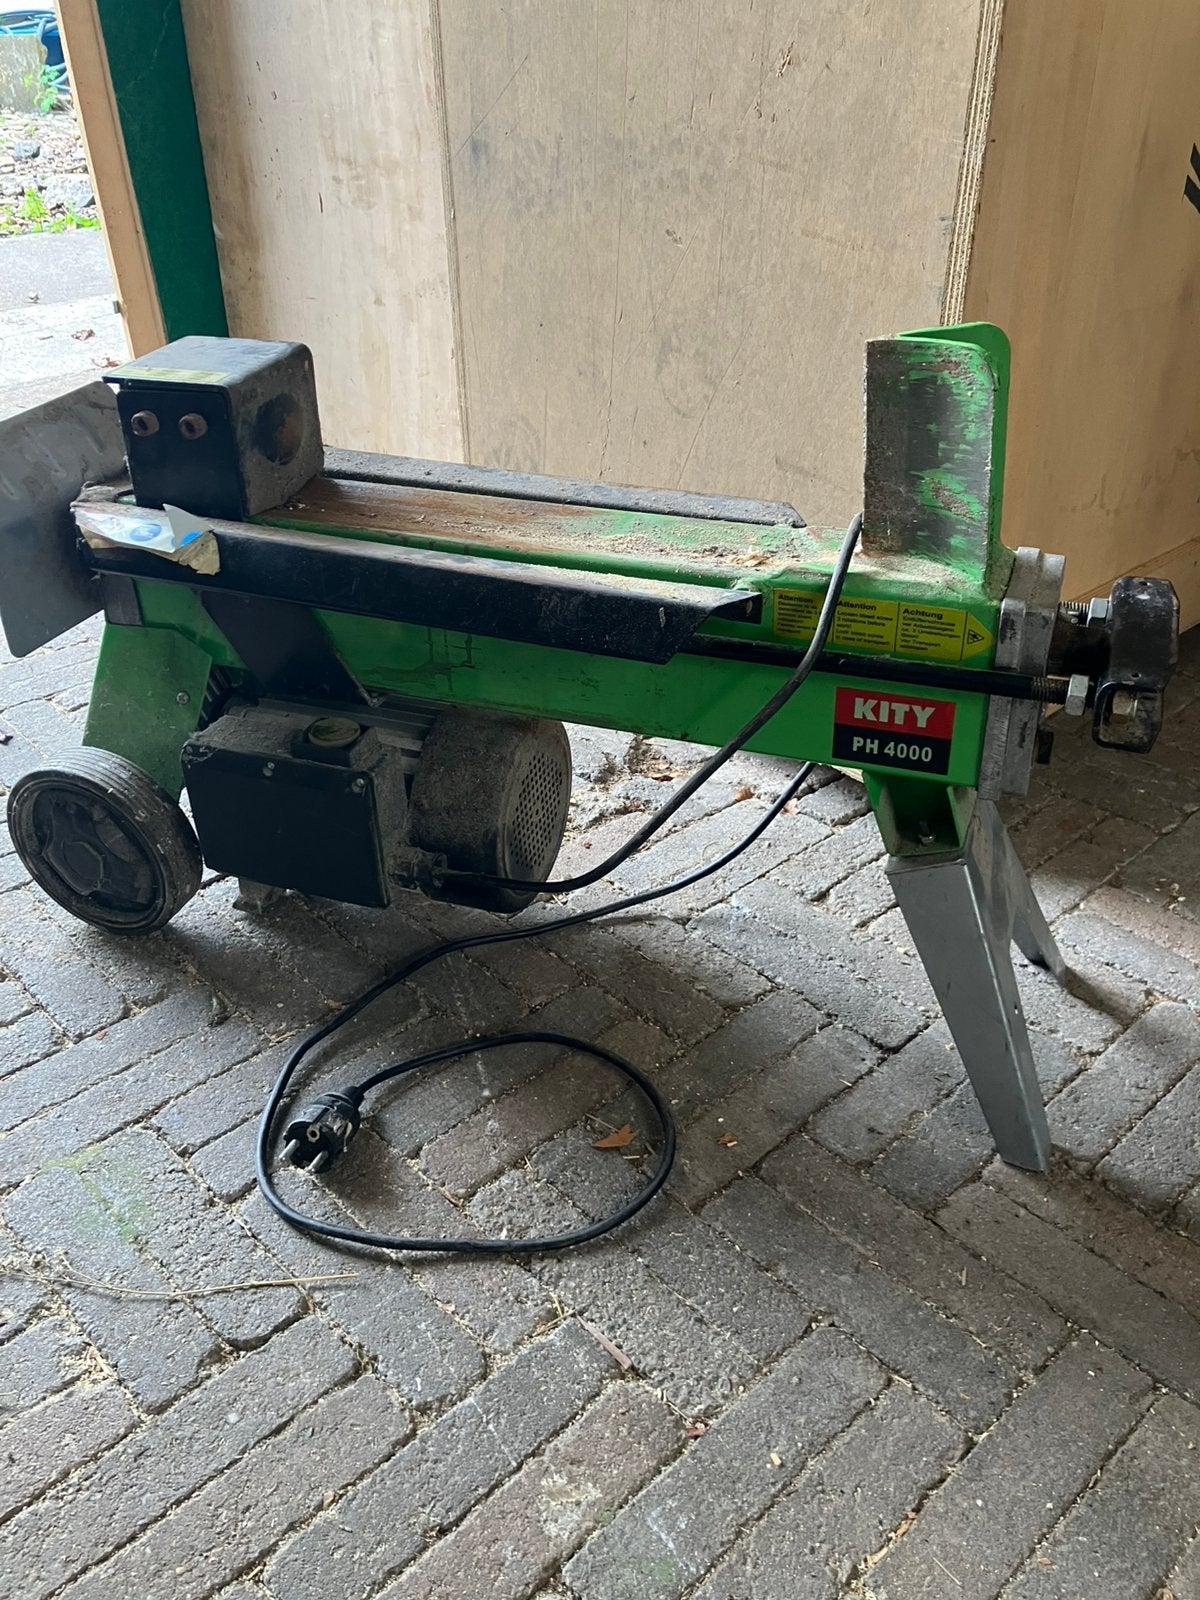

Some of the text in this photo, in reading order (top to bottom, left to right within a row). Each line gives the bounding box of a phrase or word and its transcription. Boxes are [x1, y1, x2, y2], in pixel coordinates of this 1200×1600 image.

[778, 594, 813, 604] Attention
[838, 600, 876, 611] Attention
[902, 608, 943, 620] Achtung
[853, 697, 936, 728] KITY
[852, 736, 933, 762] PH 4000
